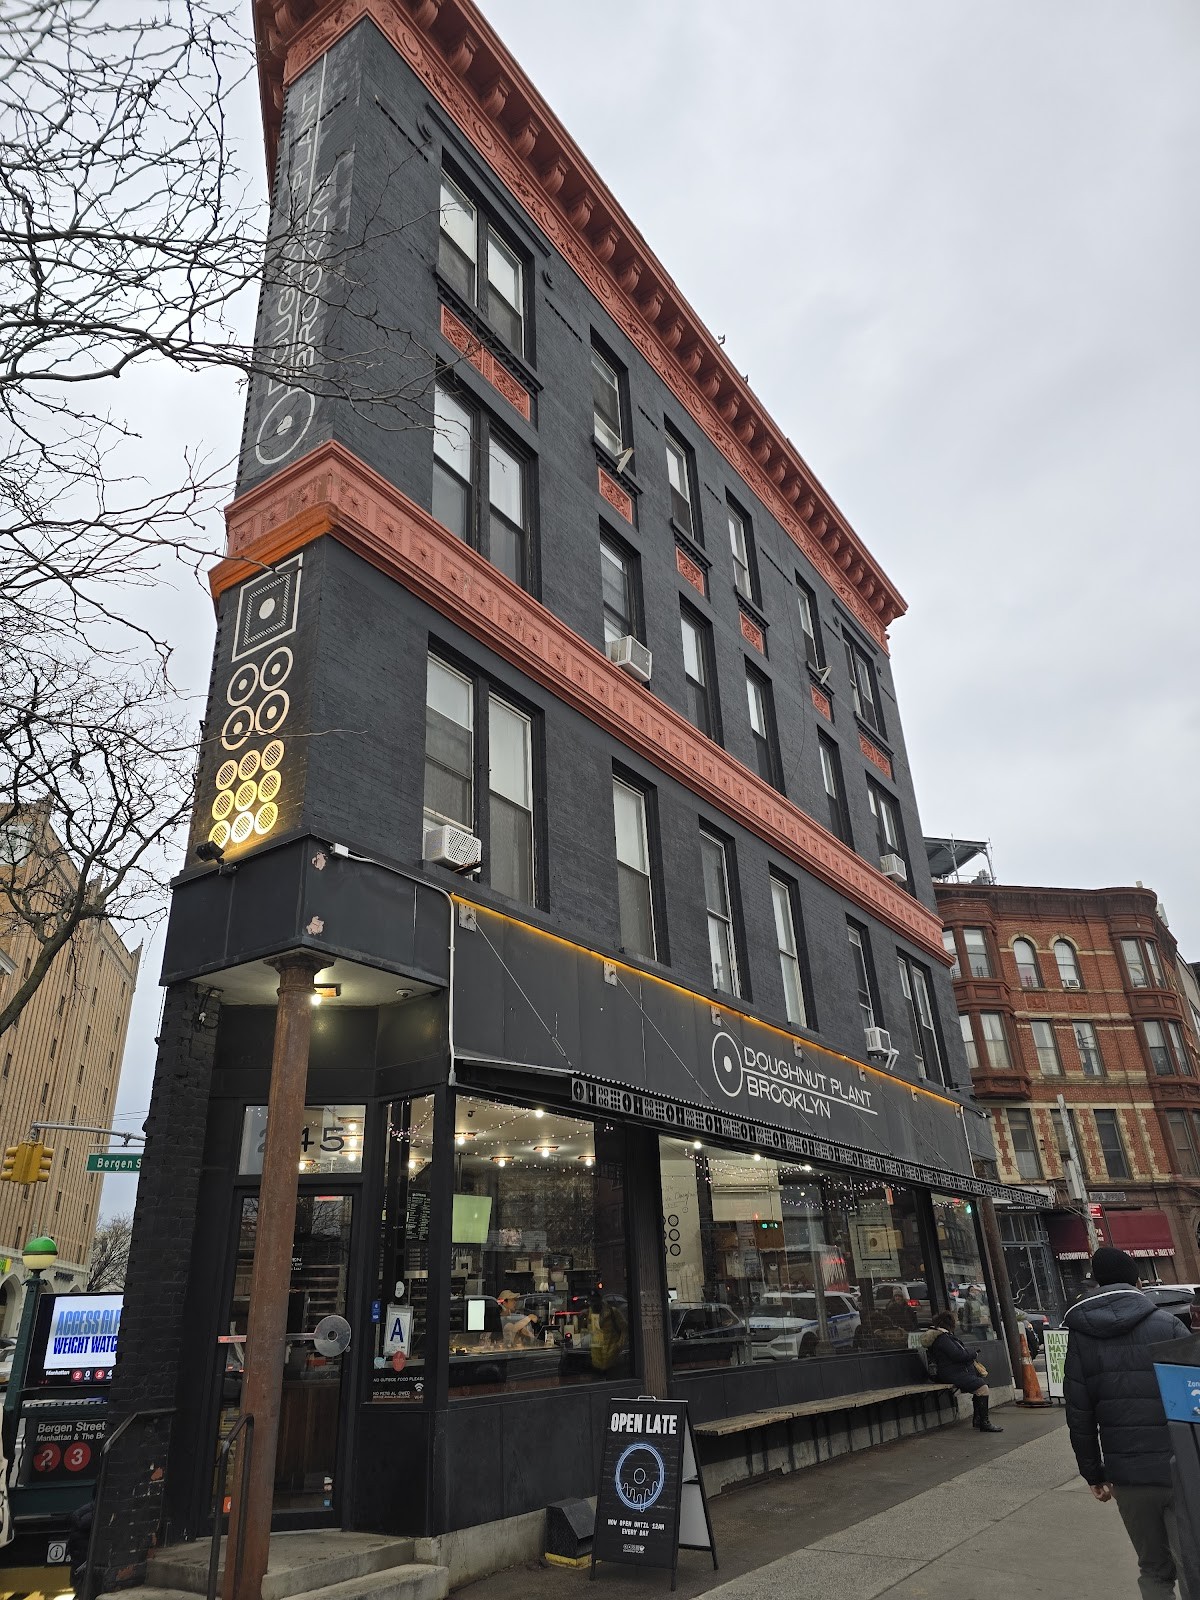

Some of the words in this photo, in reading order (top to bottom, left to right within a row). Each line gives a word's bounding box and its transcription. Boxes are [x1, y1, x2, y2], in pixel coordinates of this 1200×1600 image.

[292, 91, 318, 192] PLANT
[744, 1046, 827, 1091] DOUGHNUT
[830, 1078, 872, 1107] PLANT
[746, 1075, 831, 1119] BROOKLYN
[97, 1158, 133, 1171] Bergen
[55, 1311, 101, 1336] ACCESS
[389, 1317, 404, 1342] A
[53, 1336, 91, 1354] WEIGHT
[38, 1423, 72, 1434] Bergen
[76, 1421, 106, 1431] Street
[610, 1413, 643, 1433] OPEN
[645, 1414, 678, 1434] LATE
[82, 1432, 94, 1440] The
[40, 1449, 54, 1467] 2
[71, 1448, 84, 1465] 3
[620, 1519, 632, 1527] OPEN
[634, 1521, 650, 1529] UNTIL
[622, 1528, 638, 1536] EVERY
